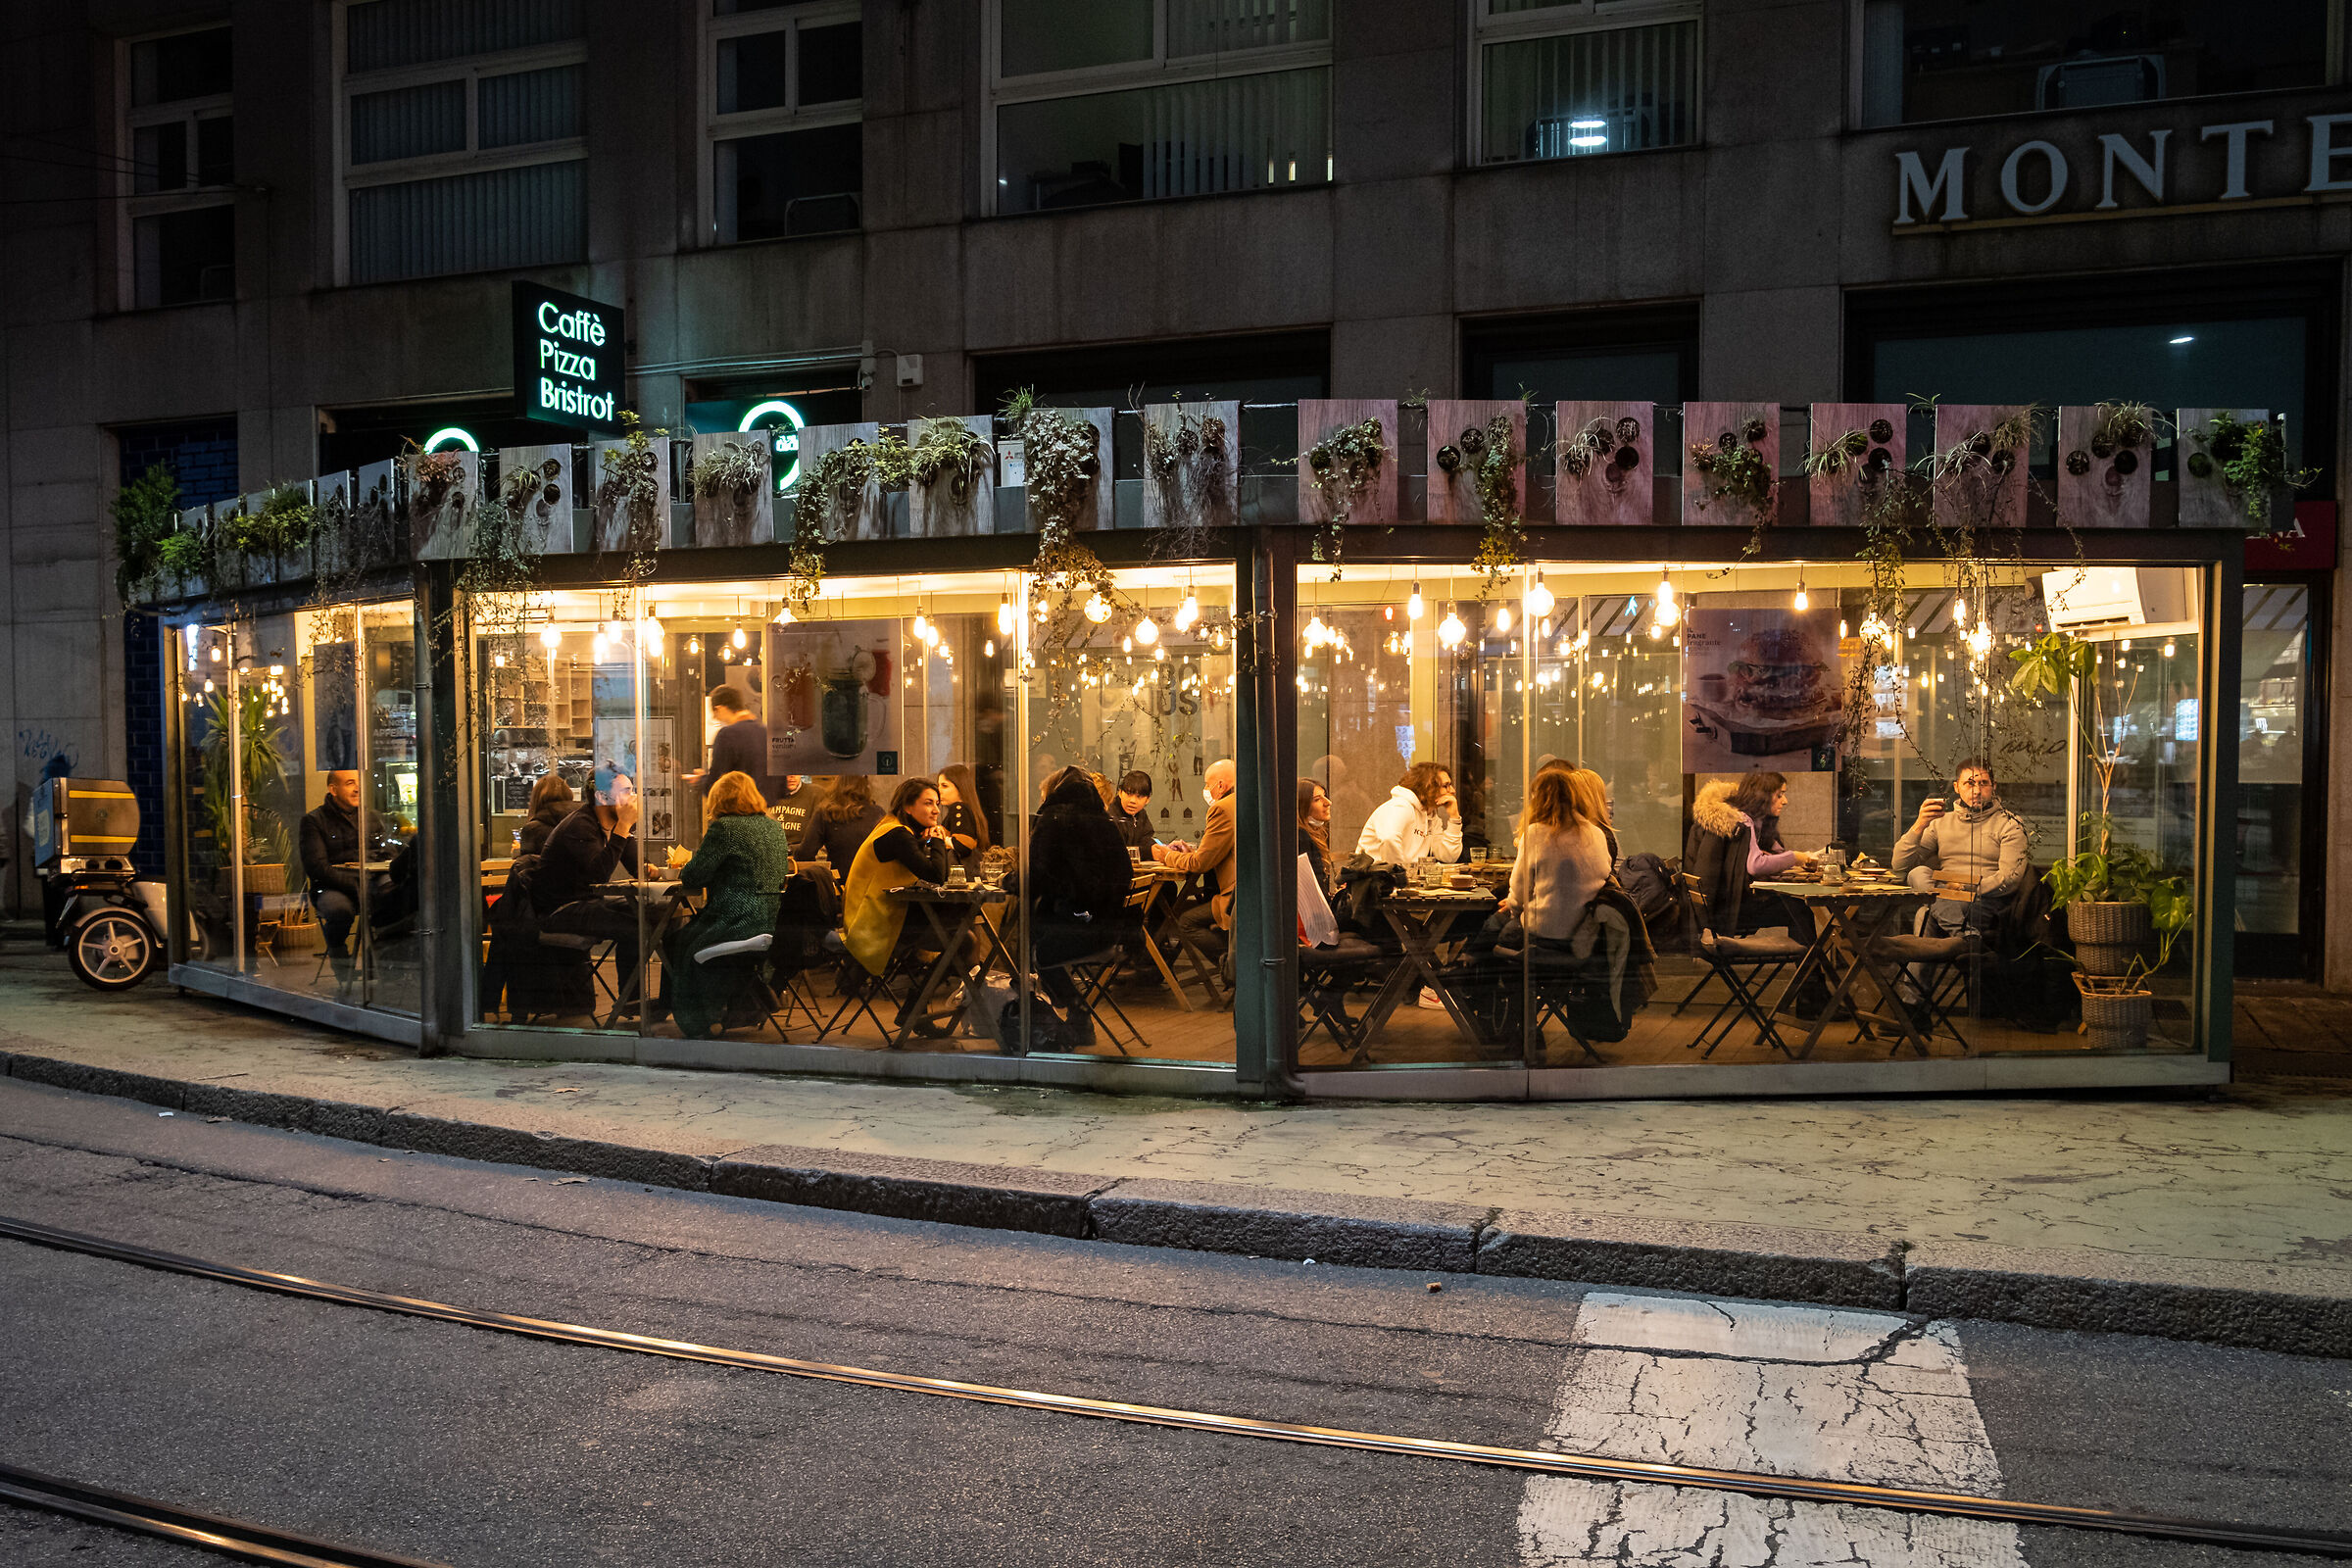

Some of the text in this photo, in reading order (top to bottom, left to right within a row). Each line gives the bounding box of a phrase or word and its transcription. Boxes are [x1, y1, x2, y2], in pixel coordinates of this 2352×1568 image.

[538, 301, 606, 347] Caffè
[540, 338, 596, 381] Pizza
[540, 376, 614, 421] Bristrot
[776, 813, 785, 822] &
[781, 821, 802, 832] AGNE
